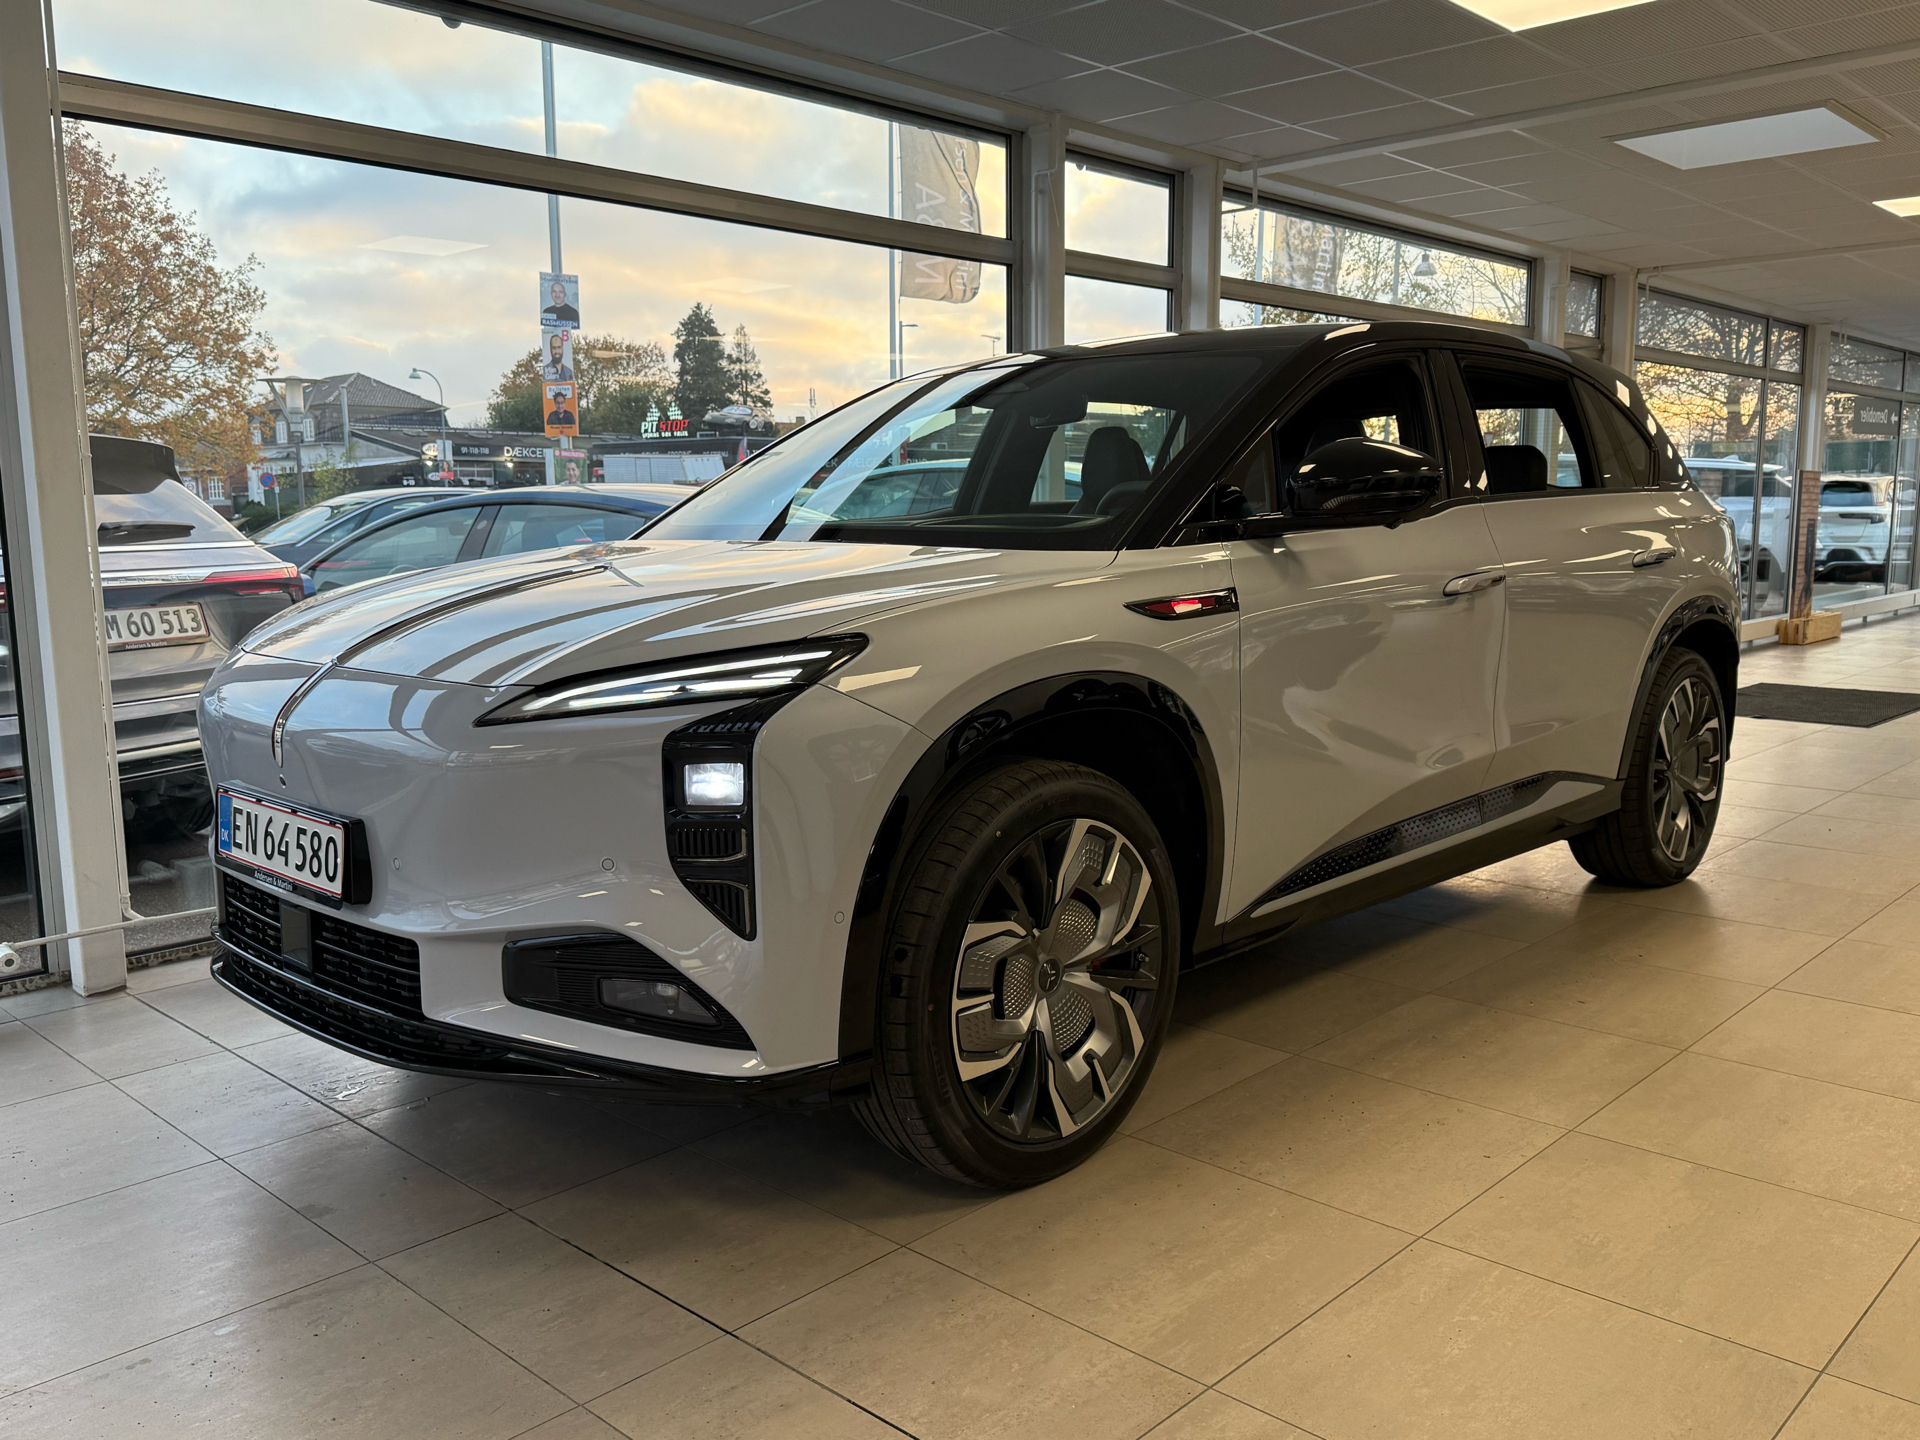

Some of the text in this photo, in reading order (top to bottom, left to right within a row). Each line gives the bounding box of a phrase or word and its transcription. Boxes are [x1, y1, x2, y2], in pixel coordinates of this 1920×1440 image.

[542, 319, 578, 328] RASMUSSEN
[561, 329, 570, 342] B
[641, 419, 689, 433] PIT STOP
[461, 446, 489, 455] 91-118-118
[126, 611, 155, 637] 60
[158, 608, 203, 635] 513
[221, 804, 338, 883] DK EN 64 580
[254, 870, 292, 891] Andersen & Martini
